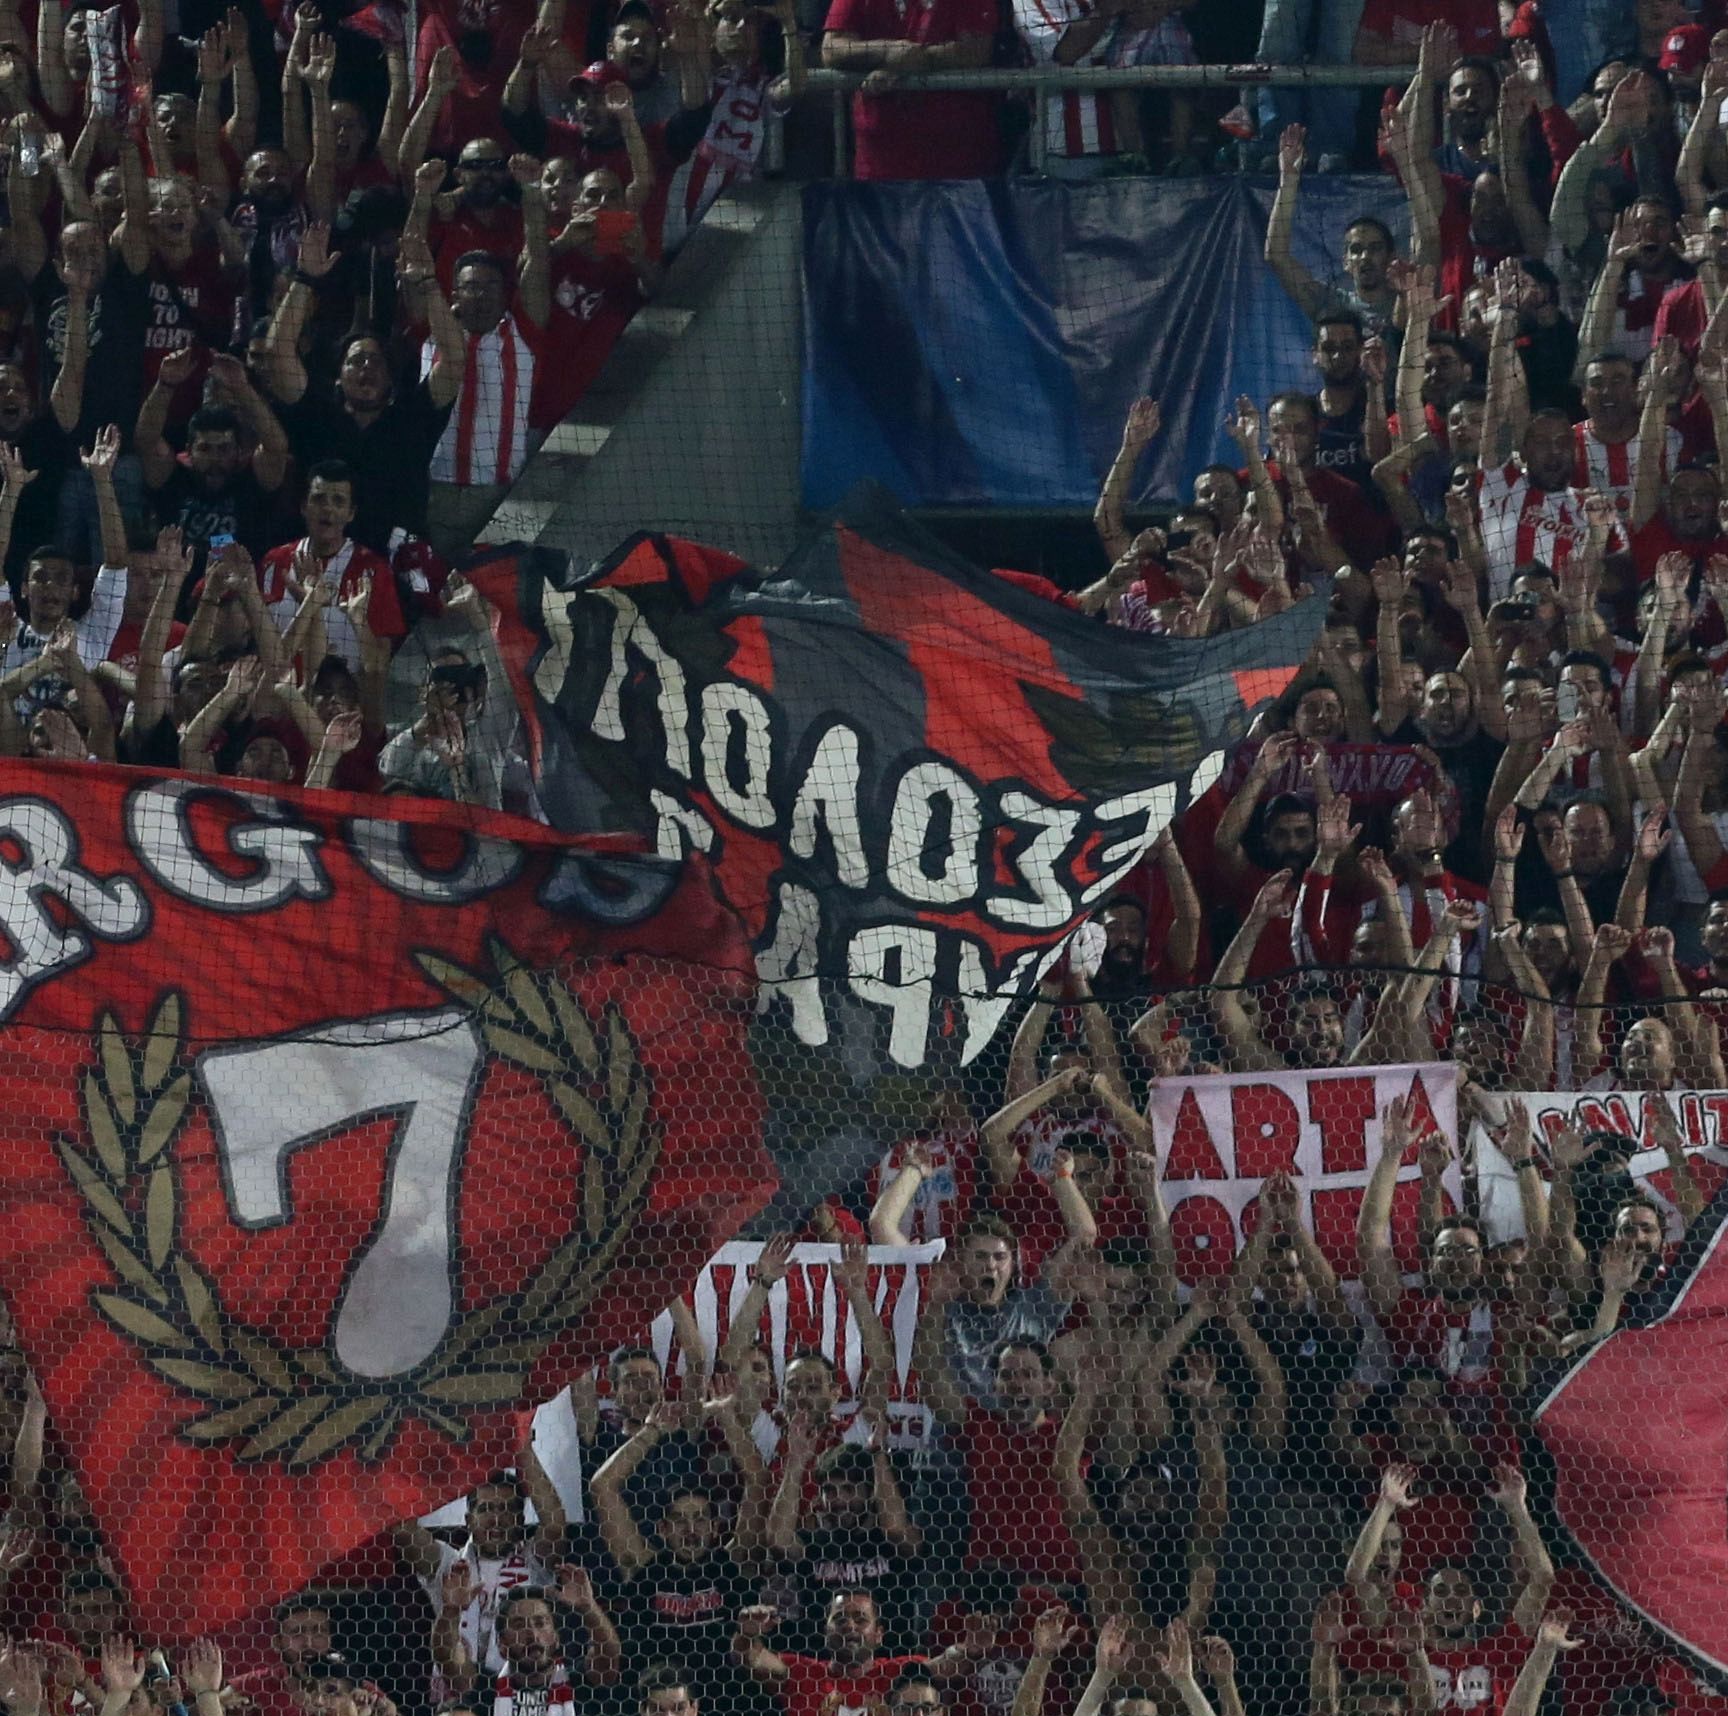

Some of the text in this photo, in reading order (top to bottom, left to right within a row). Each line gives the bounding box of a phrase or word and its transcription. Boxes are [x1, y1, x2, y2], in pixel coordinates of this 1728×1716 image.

[146, 327, 197, 349] IGHT
[1315, 442, 1360, 468] icef
[200, 1010, 484, 1380] 7
